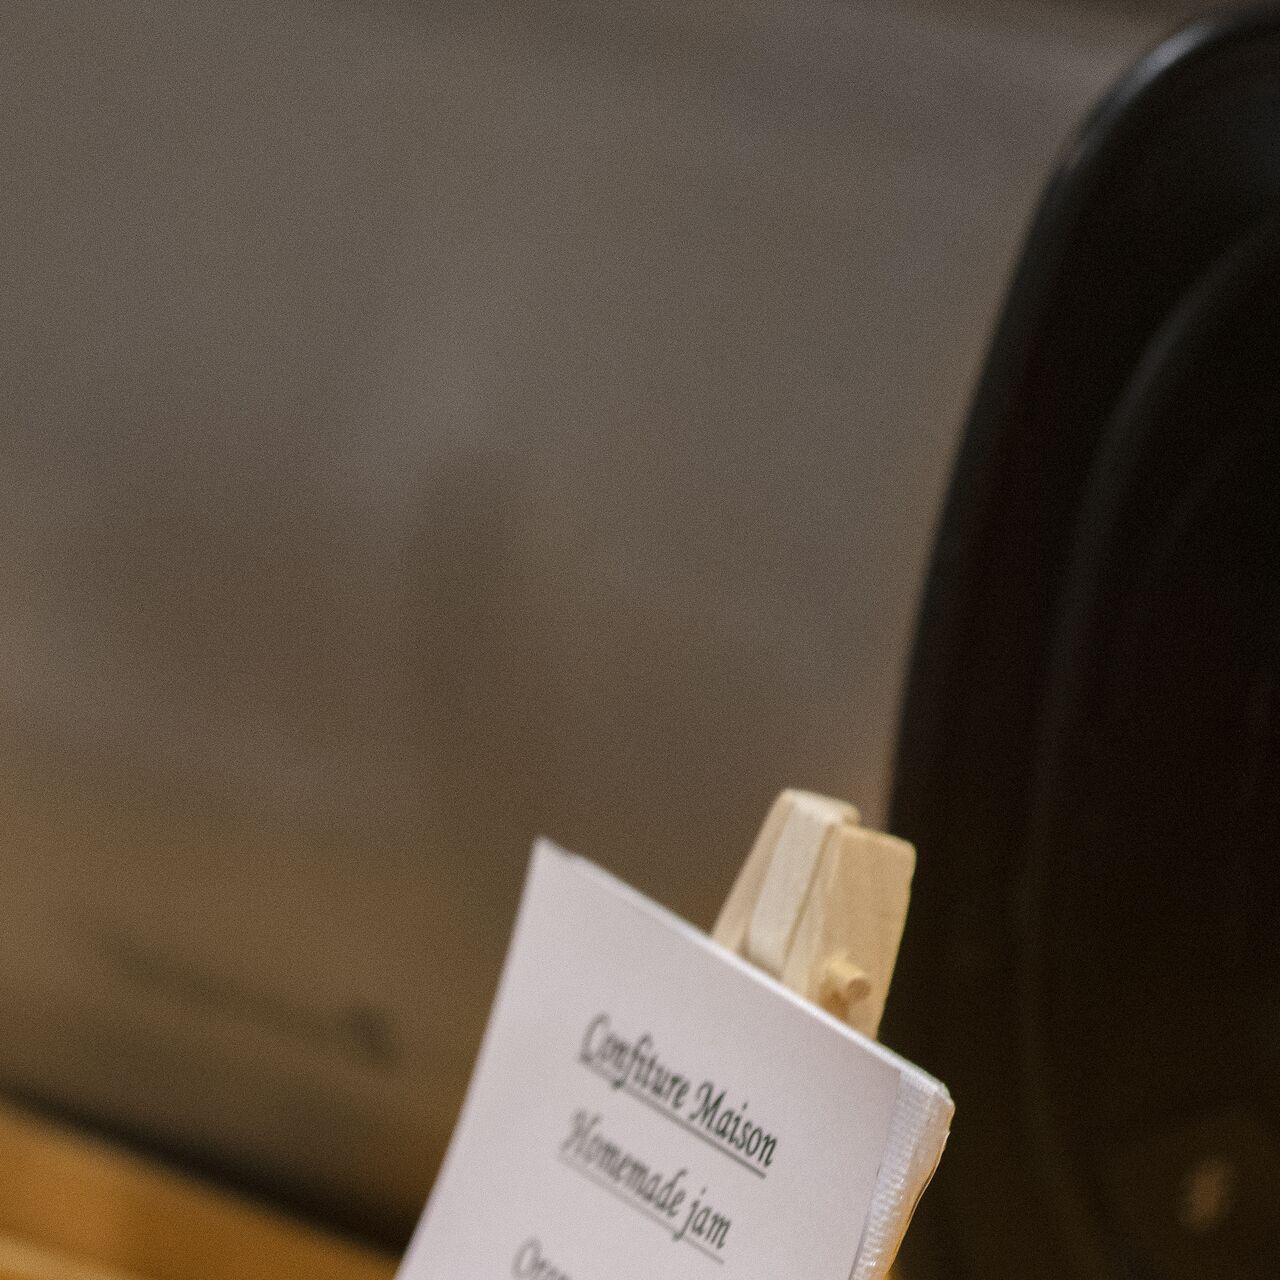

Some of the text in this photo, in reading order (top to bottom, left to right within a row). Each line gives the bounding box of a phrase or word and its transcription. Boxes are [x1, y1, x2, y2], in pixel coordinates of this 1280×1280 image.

[579, 1012, 778, 1167] Confiture Maison
[559, 1108, 732, 1250] Homemade jam
